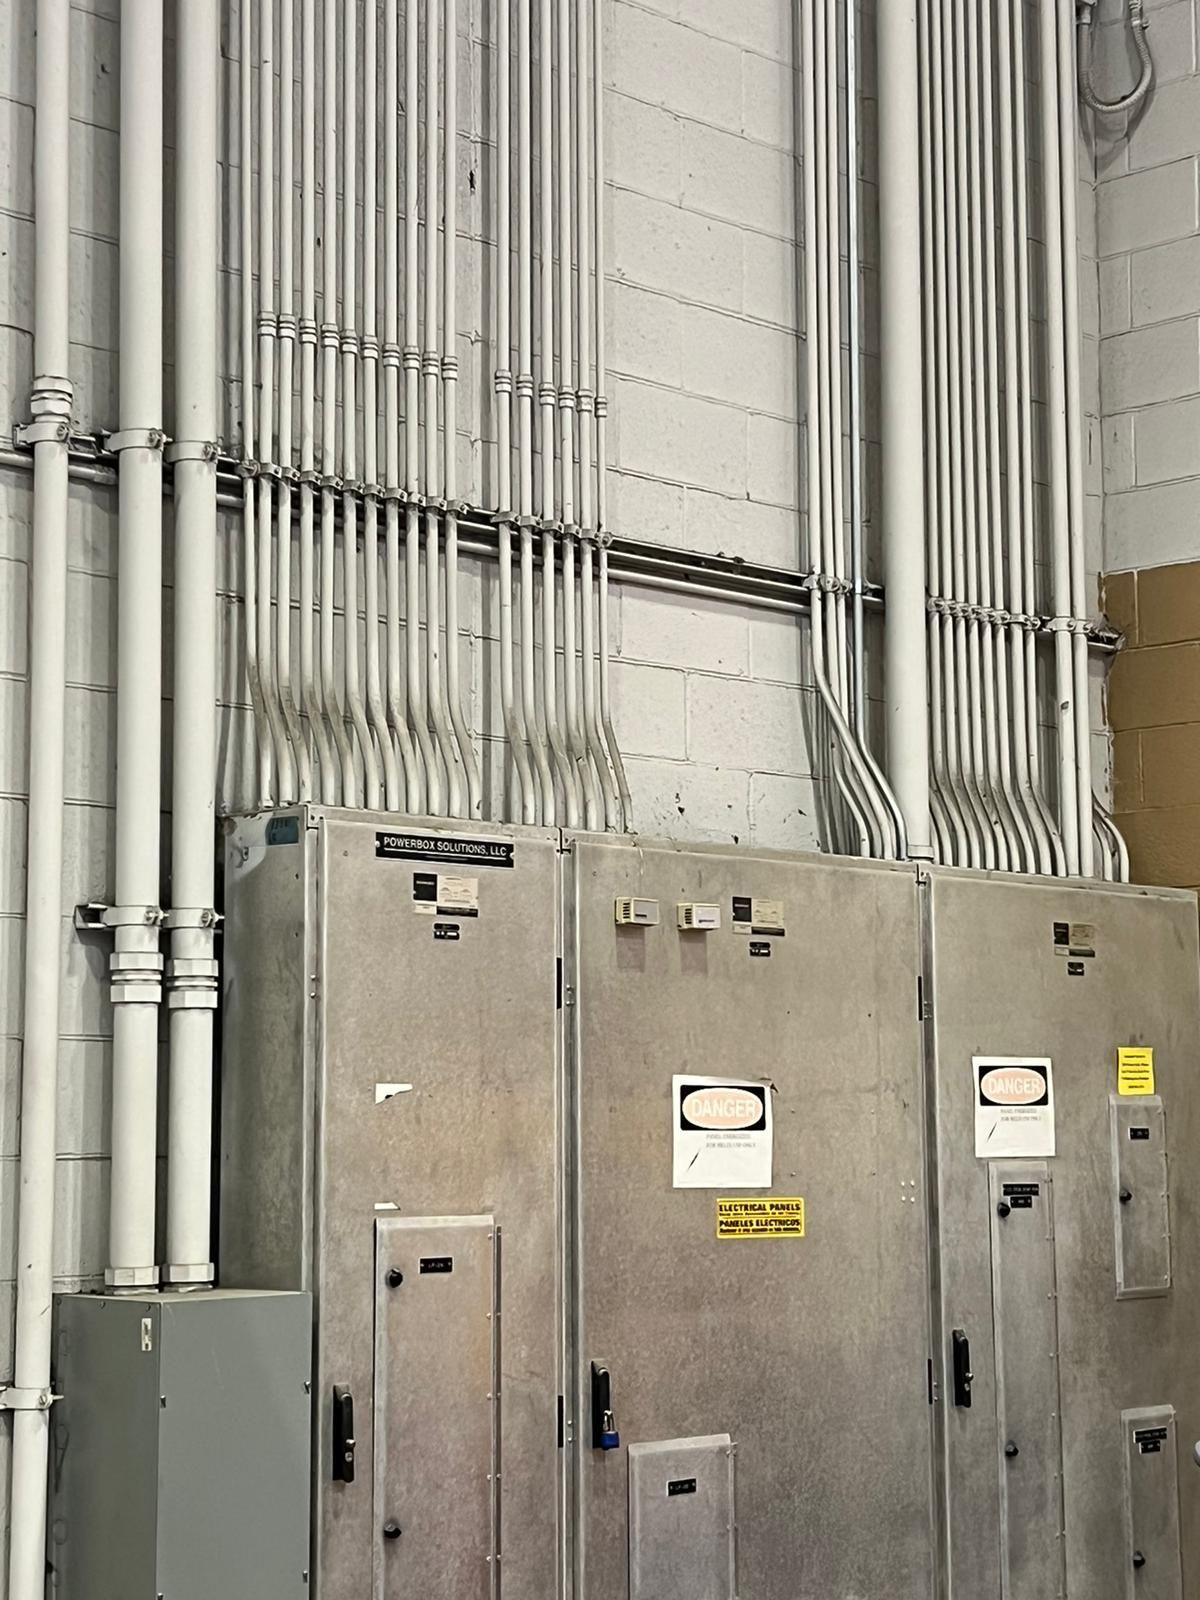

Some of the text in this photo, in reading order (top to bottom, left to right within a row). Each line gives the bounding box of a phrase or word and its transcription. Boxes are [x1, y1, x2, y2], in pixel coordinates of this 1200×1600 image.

[383, 836, 507, 856] POWERBOX SOLUTIONS, LLC
[988, 1077, 1041, 1095] DANGER
[692, 1098, 756, 1118] DANGER
[719, 1203, 801, 1212] ELECTRICAL PANELS
[719, 1219, 754, 1227] PANELES
